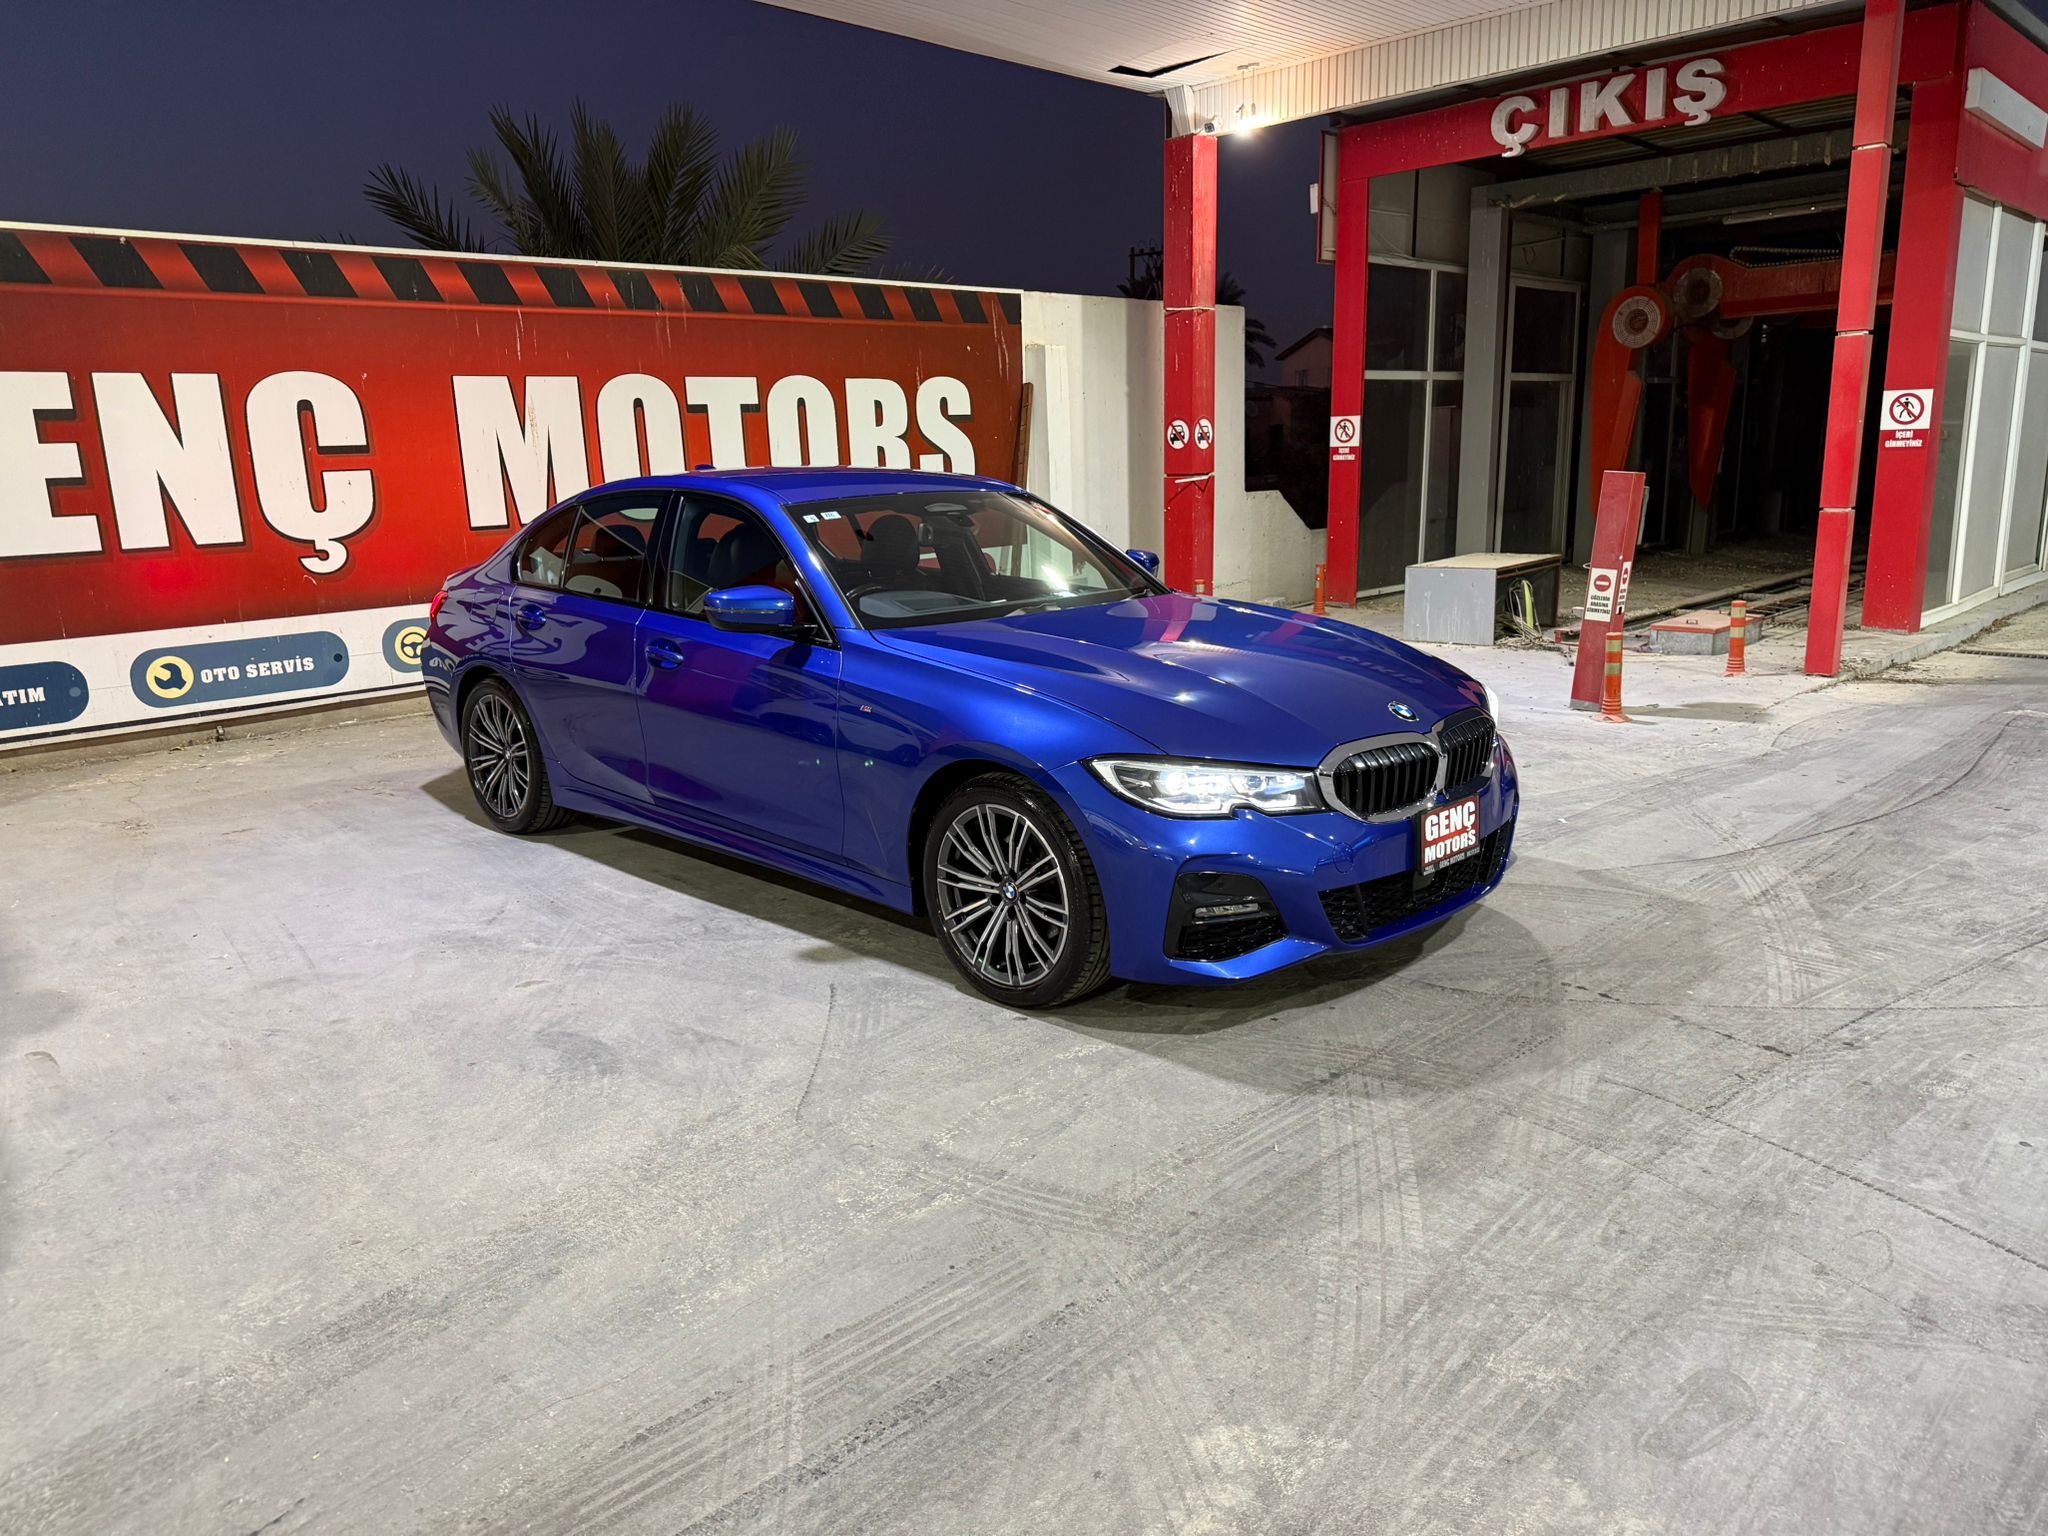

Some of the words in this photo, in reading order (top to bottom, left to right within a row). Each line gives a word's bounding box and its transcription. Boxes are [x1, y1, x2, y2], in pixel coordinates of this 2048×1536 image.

[1490, 58, 1727, 158] ÇIKIŞ
[452, 373, 974, 529] MOTORS
[200, 667, 241, 684] OTO
[246, 655, 315, 679] SERVİS
[0, 686, 46, 707] TIM
[1425, 801, 1476, 842] GENÇ
[1424, 829, 1476, 863] MOTORS
